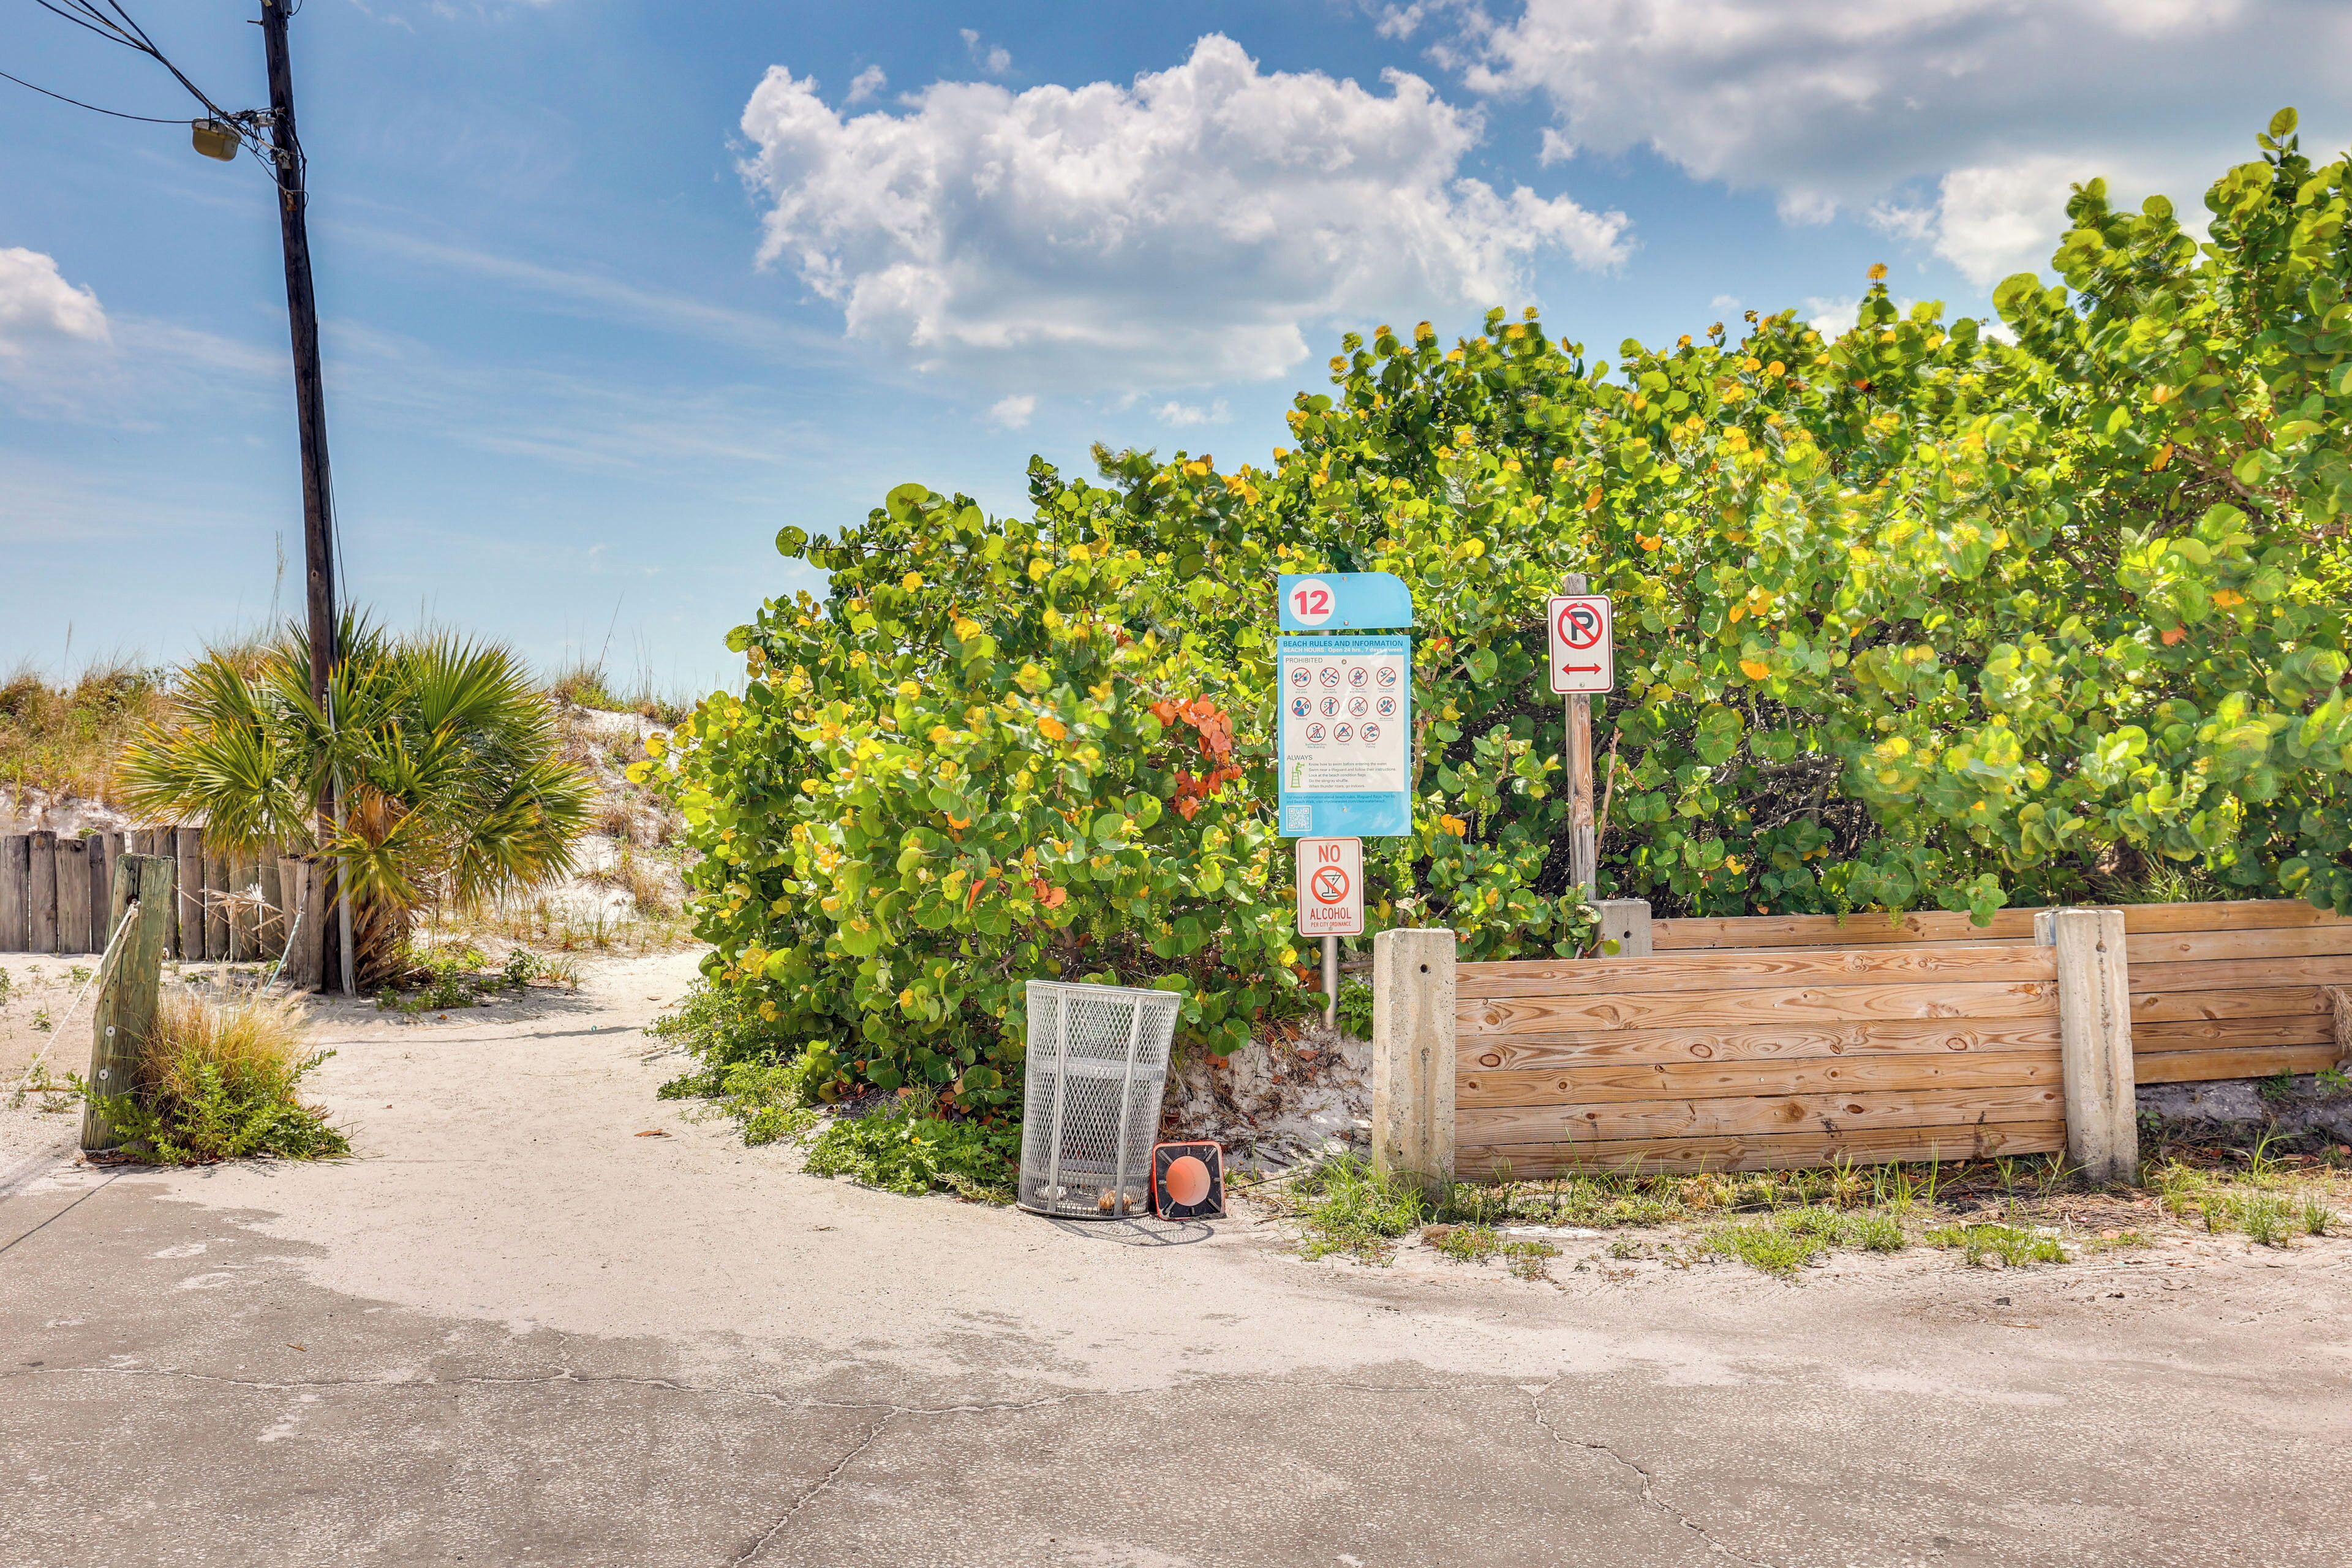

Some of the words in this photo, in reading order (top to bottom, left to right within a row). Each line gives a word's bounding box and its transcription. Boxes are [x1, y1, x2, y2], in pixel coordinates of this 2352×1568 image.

[1295, 590, 1329, 615] 12
[1318, 845, 1341, 862] NO
[1310, 907, 1352, 920] ALCOHOL
